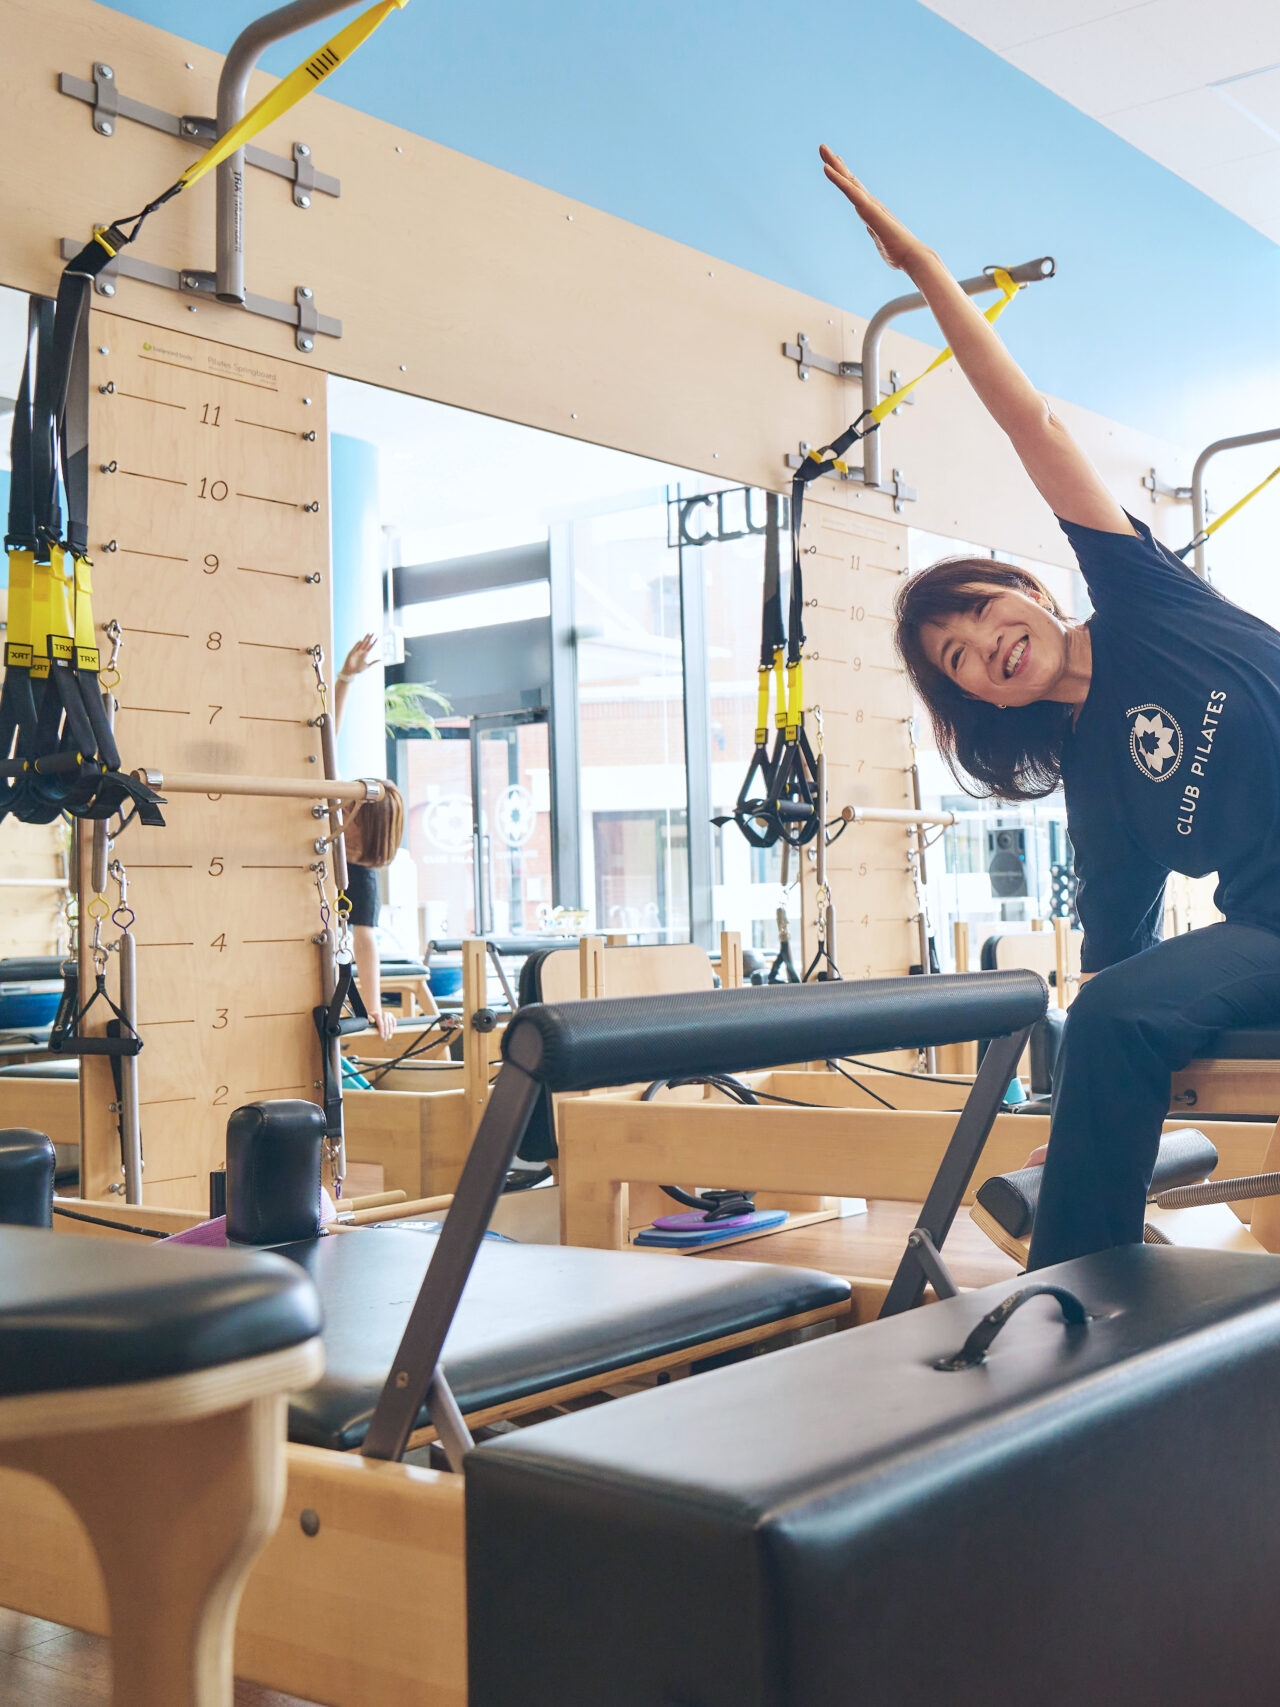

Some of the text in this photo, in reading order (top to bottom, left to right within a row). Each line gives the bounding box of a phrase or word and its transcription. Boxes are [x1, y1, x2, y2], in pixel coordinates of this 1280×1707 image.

[207, 356, 232, 369] Pilates
[233, 362, 277, 382] Springboard
[199, 403, 221, 428] 11
[197, 477, 228, 501] 10
[202, 554, 219, 575] 9
[850, 555, 861, 571] 11
[850, 606, 865, 622] 10
[55, 643, 71, 653] TRX
[206, 631, 222, 651] 8
[79, 655, 96, 664] TRX
[853, 656, 862, 672] 9
[208, 704, 223, 725] 7
[855, 709, 864, 723] 8
[857, 760, 865, 773] 7
[1177, 690, 1227, 835] CLUB PILATES
[207, 857, 224, 877] 5
[858, 863, 867, 876] 5
[861, 914, 869, 928] 4
[210, 933, 227, 952] 4
[212, 1008, 229, 1029] 3
[212, 1085, 229, 1105] 2
